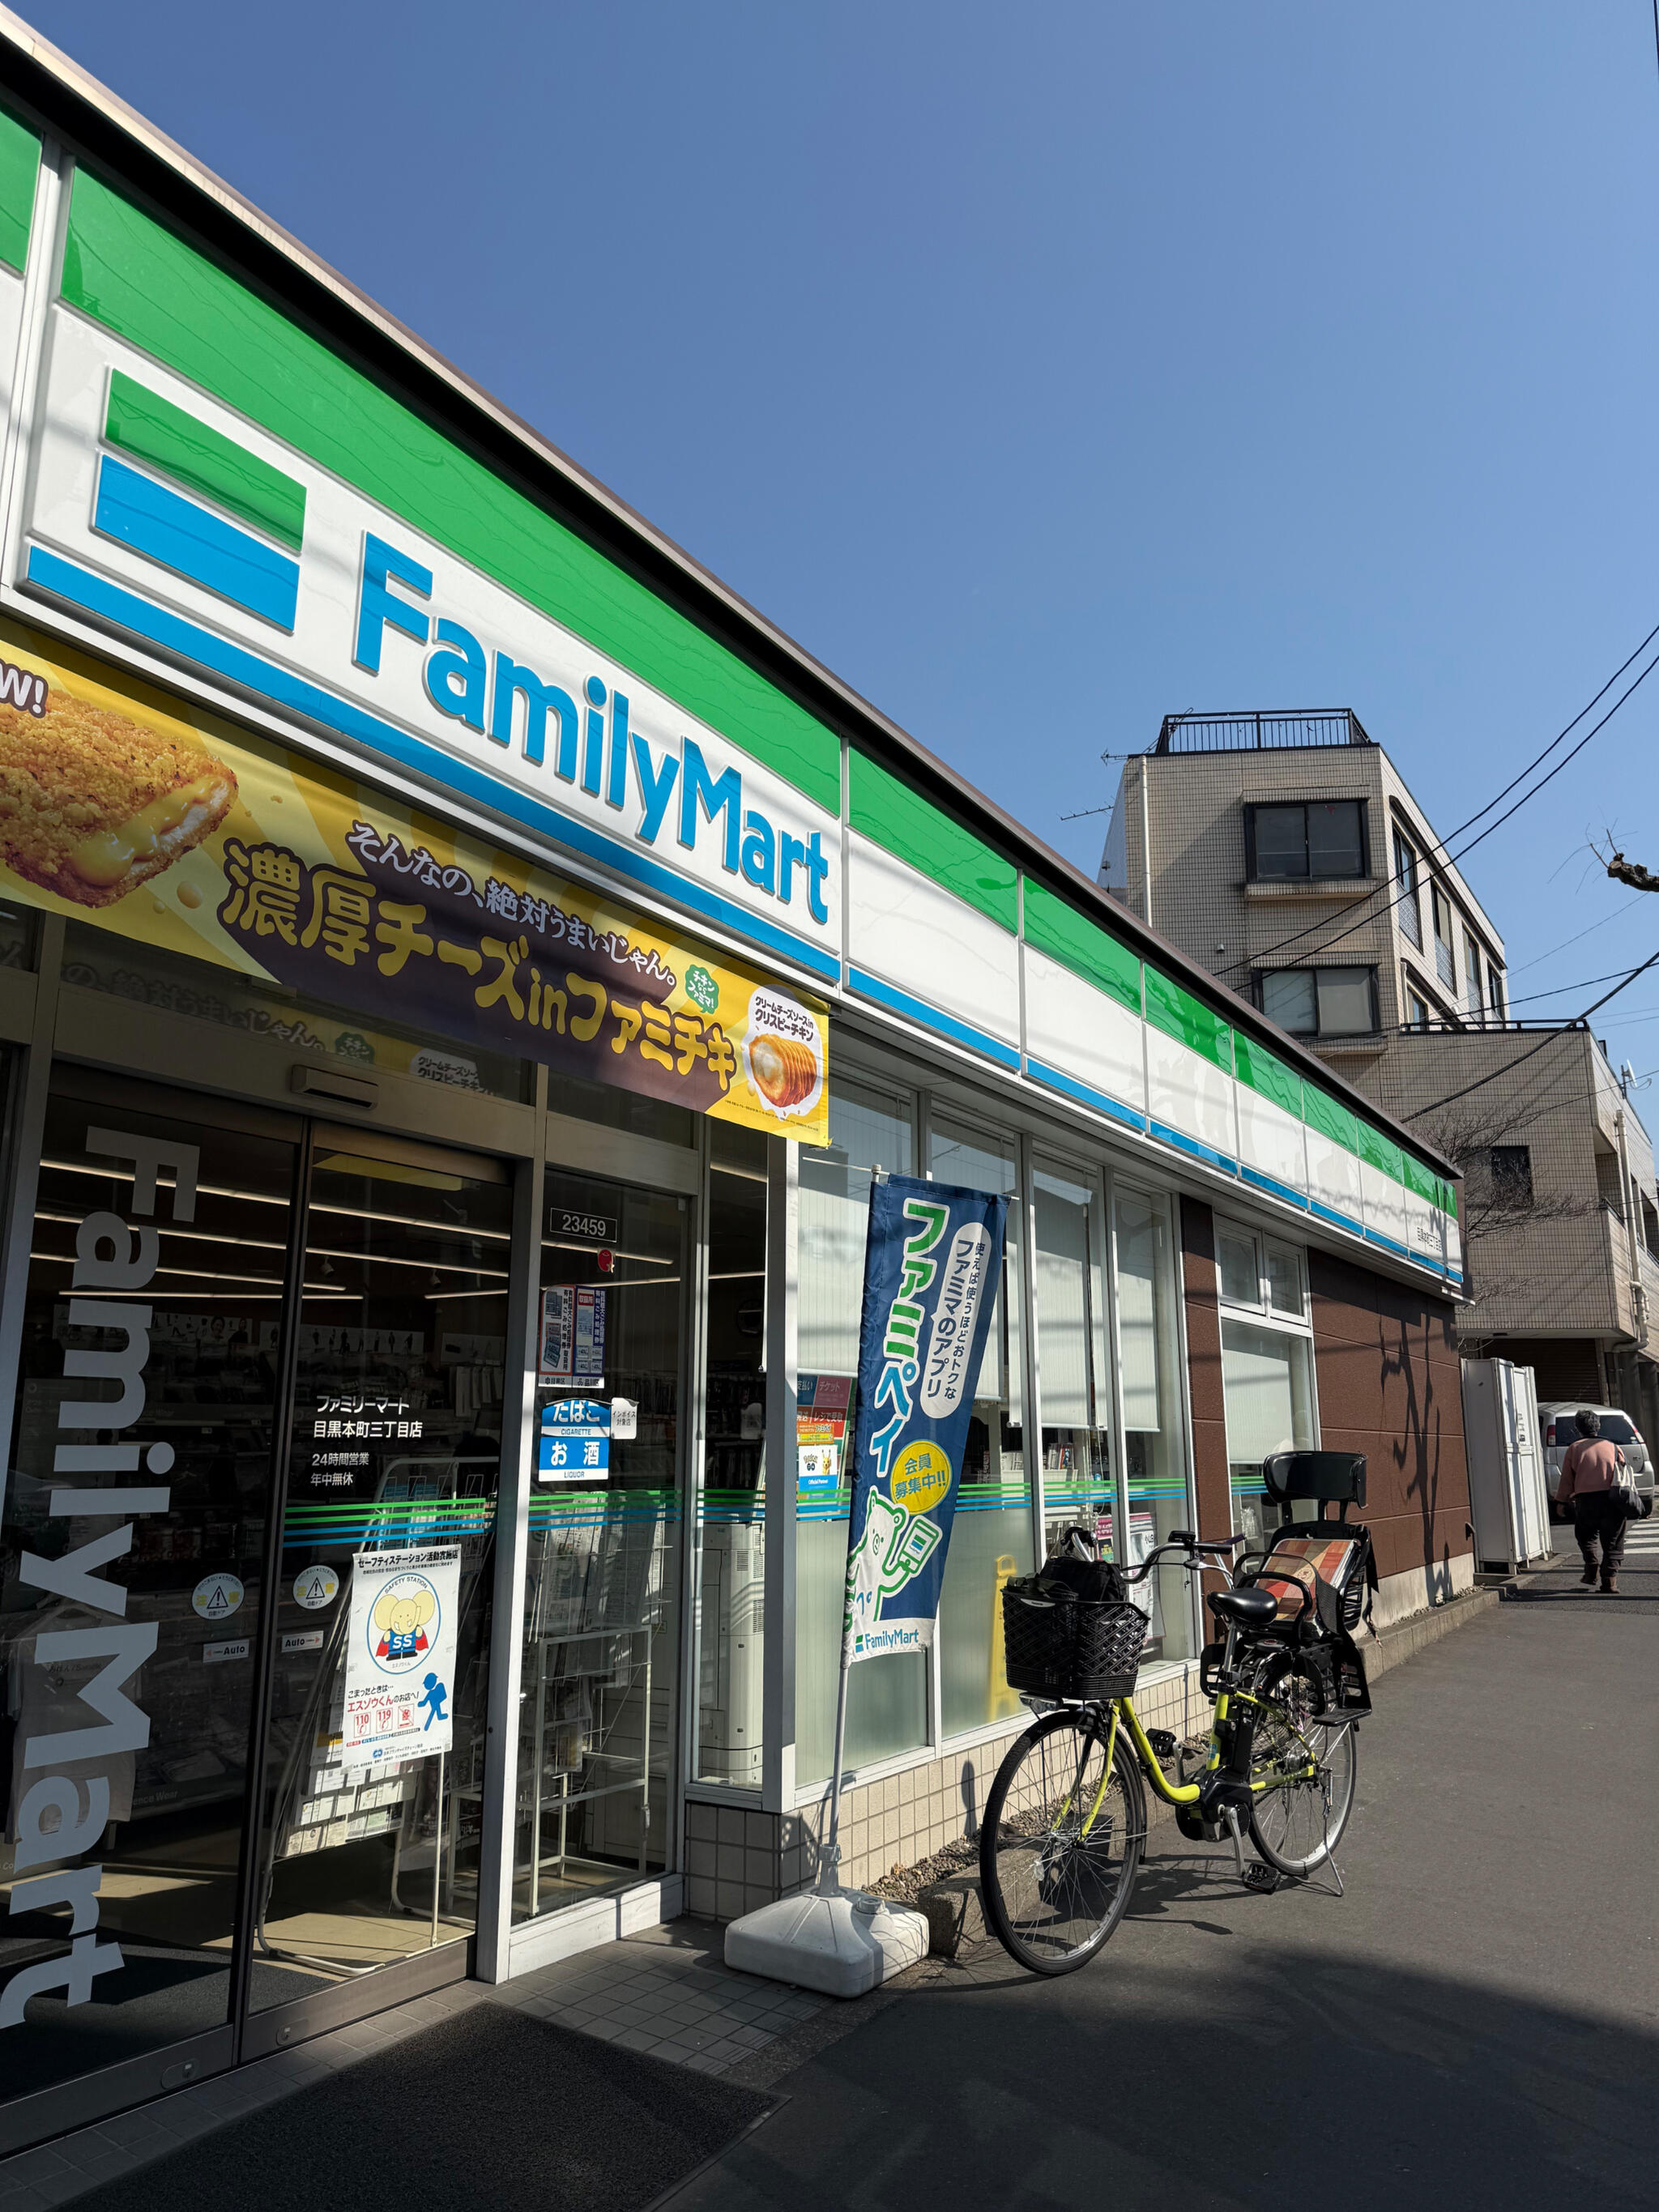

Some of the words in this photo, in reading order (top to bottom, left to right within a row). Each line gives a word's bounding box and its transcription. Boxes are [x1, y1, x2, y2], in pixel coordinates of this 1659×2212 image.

[354, 531, 830, 923] FamilyMart
[348, 822, 678, 987] そんなの、絶対うまいじゃん。
[222, 844, 736, 1091] 濃厚チーズinファミチキ
[693, 970, 715, 992] チキン
[755, 996, 814, 1029] クリームチーズソースin
[755, 1008, 814, 1042] クリスピーチキン
[562, 1213, 607, 1237] 23459
[928, 1240, 975, 1399] ファミマのアプリ
[945, 1242, 986, 1400] 使えば使うほどおトクな
[871, 1199, 949, 1477] ファミペイ
[819, 1381, 840, 1392] チケット
[316, 1395, 410, 1415] ファミリーマート
[552, 1400, 600, 1423] たばこ
[313, 1420, 423, 1438] 目黒本町三丁目店
[312, 1452, 370, 1467] 24時間営業
[904, 1453, 932, 1476] 会員
[310, 1473, 354, 1487] 年中無休
[895, 1471, 946, 1500] 募集中!!
[0, 1124, 199, 2029] FamilyMart
[385, 1577, 406, 1594] SAFETY
[407, 1576, 429, 1589] STATION
[285, 1635, 305, 1647] Auto
[393, 1634, 413, 1649] SS
[865, 1628, 919, 1650] FamilyMart
[224, 1646, 245, 1656] Auto
[356, 1714, 369, 1725] 110
[378, 1709, 391, 1721] 119
